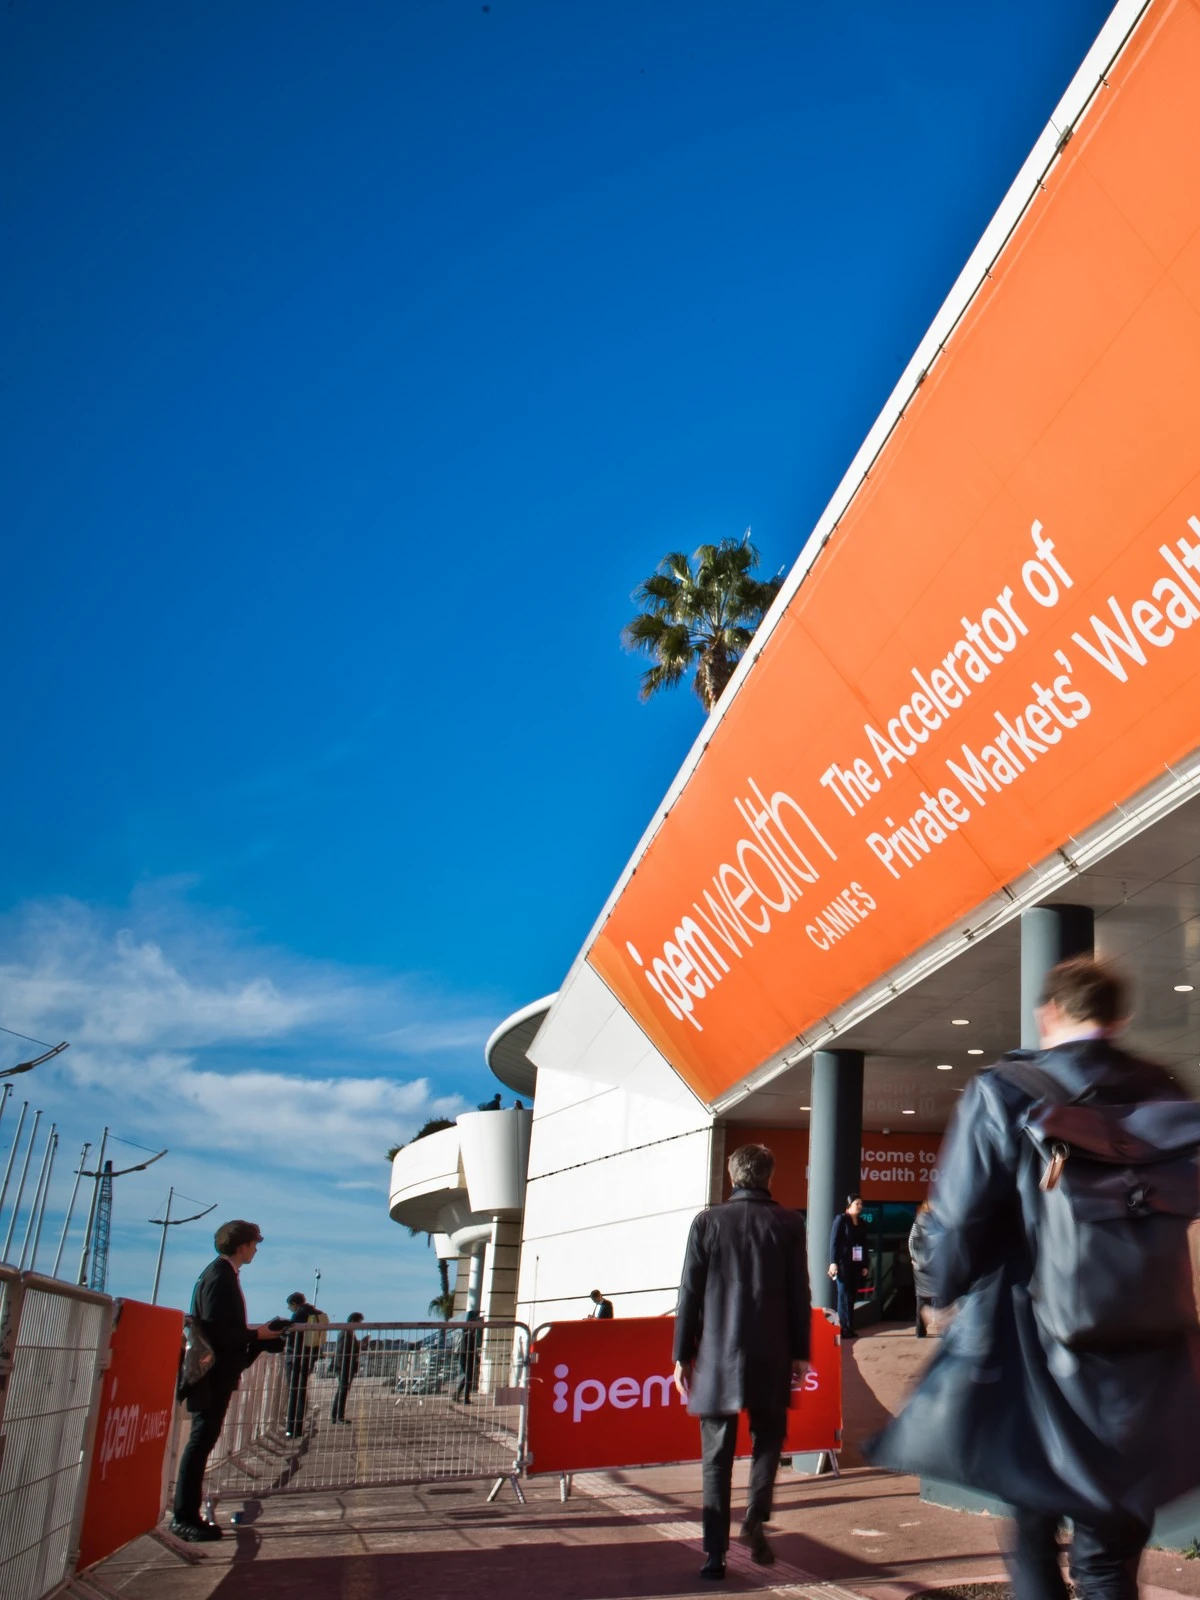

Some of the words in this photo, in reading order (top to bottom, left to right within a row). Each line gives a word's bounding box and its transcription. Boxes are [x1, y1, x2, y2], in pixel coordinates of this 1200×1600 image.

[819, 756, 881, 816] The
[863, 585, 1029, 779] Accelerator
[1022, 520, 1073, 607] of
[866, 788, 971, 879] Private
[805, 881, 877, 951] CANNES
[627, 915, 731, 1032] ipem
[861, 1147, 915, 1163] lcome
[919, 1150, 936, 1163] to
[140, 1408, 168, 1443] CANNES
[553, 1364, 690, 1422] ipem
